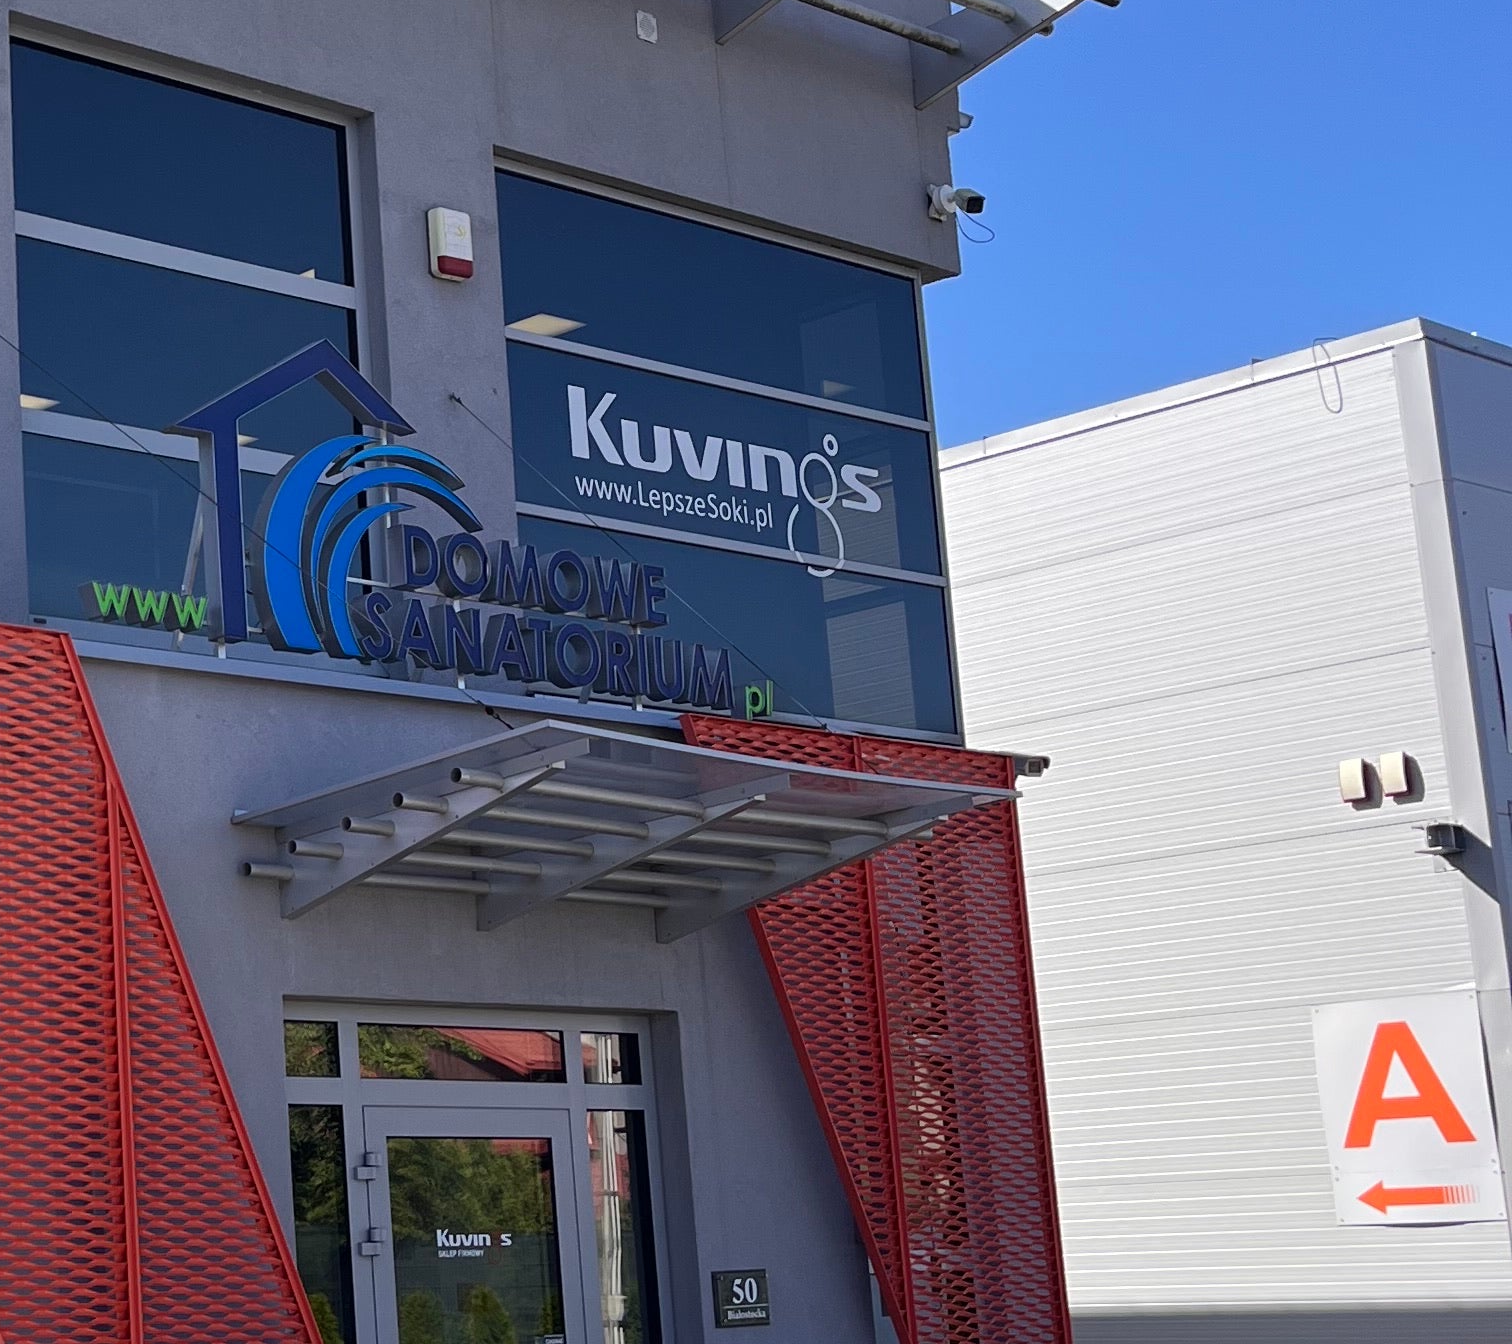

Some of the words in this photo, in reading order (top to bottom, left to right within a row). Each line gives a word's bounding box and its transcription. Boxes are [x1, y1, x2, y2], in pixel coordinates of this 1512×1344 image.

[566, 383, 883, 579] Kuvings
[573, 474, 774, 533] www.LepszeSoki.pl
[398, 523, 670, 627] DOMOWE
[360, 590, 736, 712] SANATORIUM
[1343, 1020, 1478, 1150] A
[436, 1228, 512, 1247] Kuvins
[732, 1277, 758, 1304] 50
